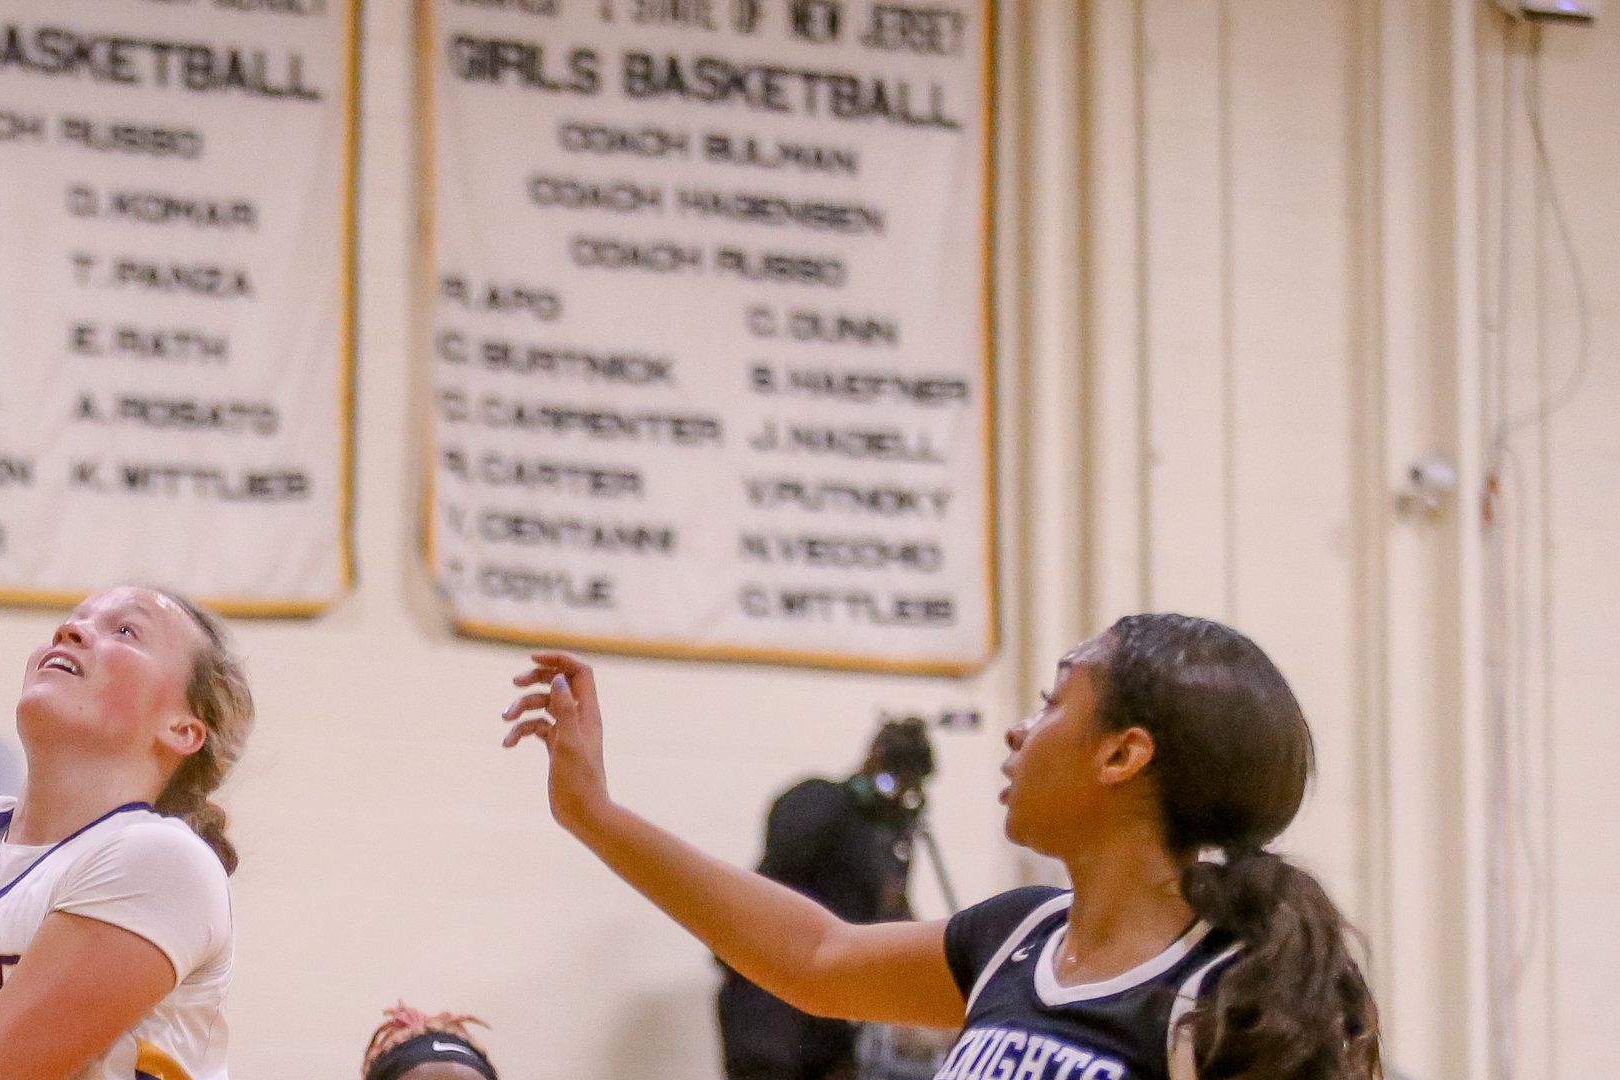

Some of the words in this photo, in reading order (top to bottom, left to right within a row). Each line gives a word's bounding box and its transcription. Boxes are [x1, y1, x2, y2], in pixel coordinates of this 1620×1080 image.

[447, 30, 605, 98] GIRLS
[621, 46, 966, 134] BASKETBALL
[60, 114, 205, 160] RUSSO
[557, 117, 691, 159] COACH
[527, 172, 665, 215] COACH
[569, 233, 705, 274] COACH
[713, 245, 848, 289] RUSSO
[480, 394, 727, 445] CARPENTER
[480, 450, 646, 499] CARTER
